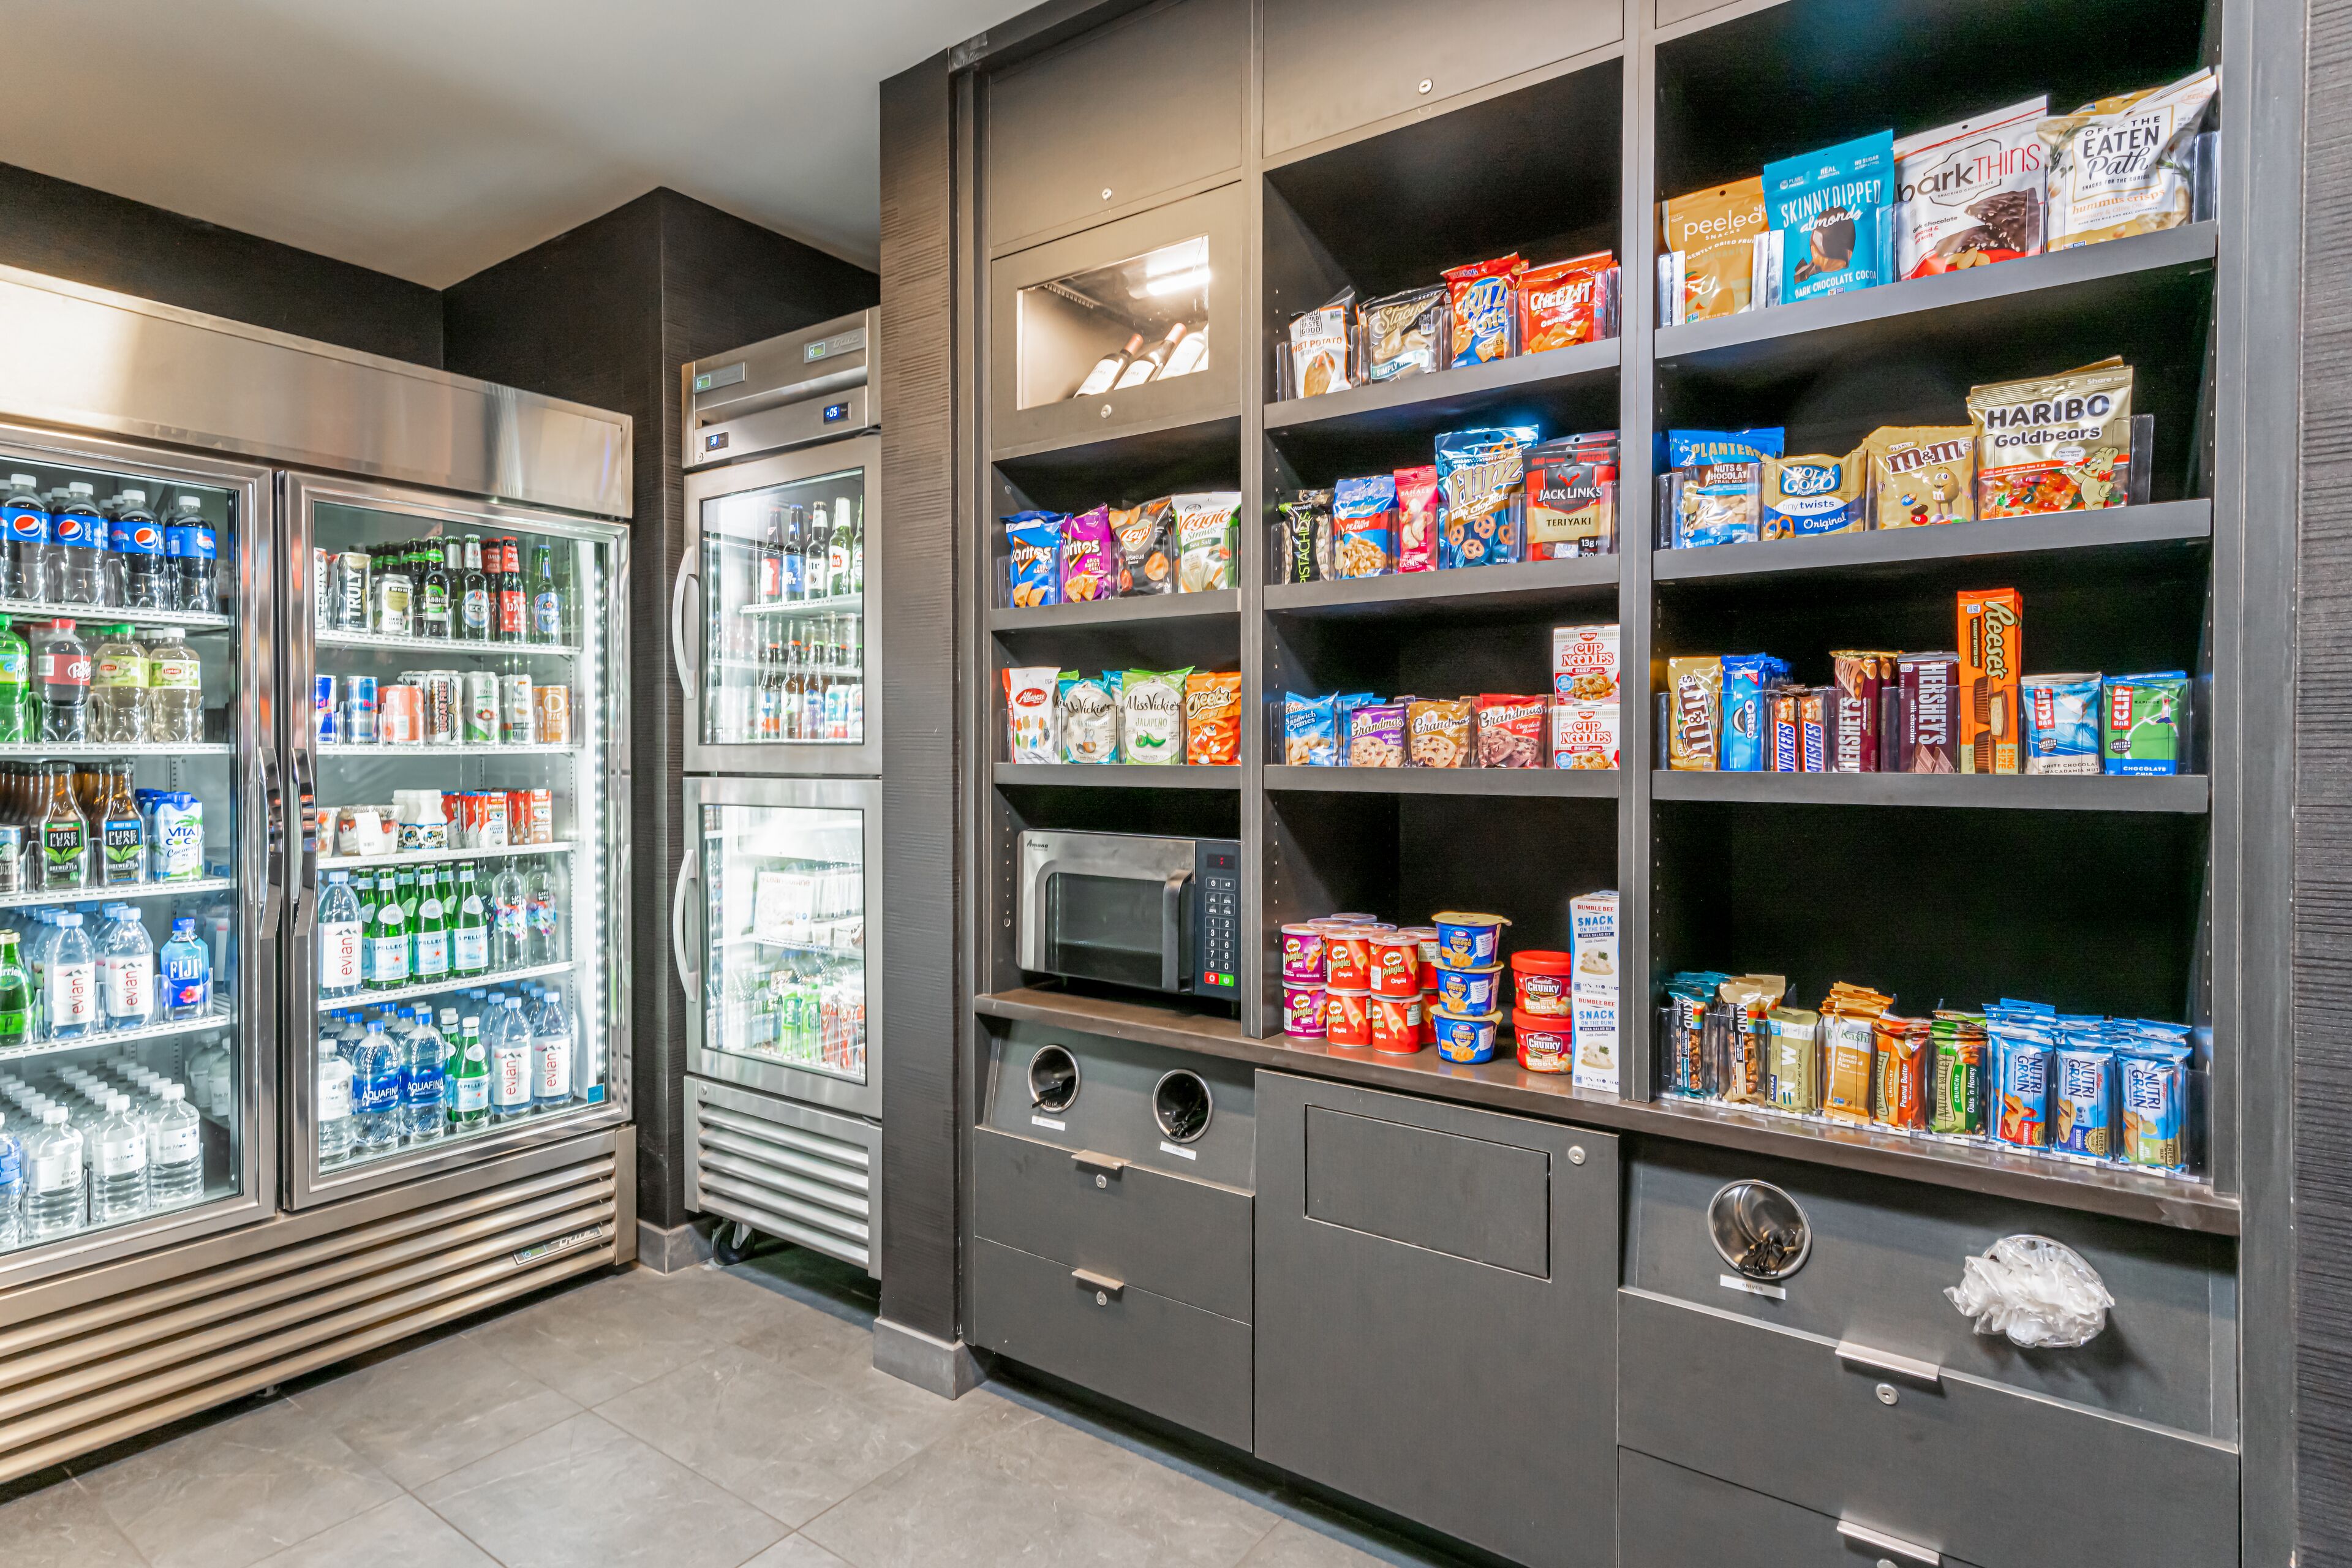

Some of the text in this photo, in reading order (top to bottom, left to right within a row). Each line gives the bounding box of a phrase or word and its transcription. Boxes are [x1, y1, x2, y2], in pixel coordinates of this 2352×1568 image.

[2132, 116, 2160, 127] THE
[2083, 126, 2160, 160] EATEN
[1820, 166, 1836, 175] REAL
[2087, 147, 2150, 180] Path
[1938, 181, 1994, 198] SNACKING CHOCOLATE
[2073, 188, 2166, 216] hummus crisps
[1684, 205, 1762, 242] peeled
[1799, 204, 1863, 233] almonds
[1705, 228, 1740, 241] SNACKS
[1795, 270, 1877, 300] DARK CHOCOLATE COCOA
[1378, 301, 1427, 332] Stacy's
[1376, 362, 1398, 377] SIMPLY
[826, 407, 838, 419] -05
[1986, 395, 2110, 429] HARIBO
[1994, 426, 2101, 448] Goldbears
[1890, 442, 1915, 452] PEANUT
[1714, 464, 1735, 473] NUTS
[1401, 488, 1430, 497] SAHALE
[1449, 458, 1523, 512] Flipz
[1783, 475, 1836, 494] GOLD
[1538, 487, 1603, 502] JACK LINK'S
[1783, 499, 1835, 512] tiny twists
[1178, 510, 1231, 535] Veggie
[1346, 521, 1370, 531] PEANUTS
[1547, 518, 1591, 527] TERIYAKI
[1803, 512, 1847, 530] Original
[1121, 523, 1152, 541] Lay's
[1186, 527, 1216, 542] Straws
[1581, 539, 1594, 548] 13g
[347, 570, 362, 617] TRULY
[1574, 643, 1604, 655] CUP
[1985, 601, 2017, 679] Reese's
[1562, 653, 1614, 666] NOODLES
[439, 681, 448, 733] SUGAR FREE
[1125, 693, 1181, 717] Miss Vickie's
[1918, 665, 1947, 745] HERSHEY'S
[2037, 690, 2052, 718] CLIF
[2114, 688, 2130, 717] CLIF
[1135, 717, 1168, 728] JALAPEÑO
[1286, 710, 1316, 725] Sandwich
[1287, 717, 1316, 731] Cremes
[1479, 704, 1544, 728] Grandma's
[1744, 699, 1757, 739] OREO
[1352, 717, 1403, 737] Grandma's
[1572, 722, 1602, 733] CUP
[1838, 697, 1861, 773] HERSHEY'S
[1561, 731, 1611, 744] NOODLES
[1997, 748, 2007, 769] SIZE
[2007, 748, 2015, 769] KING
[50, 832, 77, 841] PURE
[108, 831, 137, 840] PURE
[168, 827, 195, 837] VITA
[50, 837, 78, 846] LEAF
[108, 837, 137, 846] LEAF
[167, 843, 197, 858] Coconut
[1027, 839, 1049, 850] Amana
[1577, 915, 1614, 927] SNACK
[341, 937, 353, 976] evian
[1286, 951, 1304, 963] Pringles
[1331, 959, 1351, 971] Pringles
[170, 959, 200, 979] FIJI
[1382, 965, 1405, 979] Pringles
[72, 977, 84, 1015] evian
[126, 970, 138, 1007] evian
[1527, 982, 1559, 993] CHUNKY
[1292, 1007, 1313, 1021] Pringles
[1578, 1010, 1615, 1020] SNACK
[1683, 1000, 1694, 1028] KIND
[1736, 1003, 1747, 1033] KIND
[1528, 1038, 1561, 1051] CHUNKY
[1841, 1029, 1870, 1044] Kashi
[1838, 1051, 1858, 1061] Honey
[1838, 1057, 1863, 1066] Almond
[505, 1056, 517, 1095] evian
[546, 1051, 557, 1087] evian
[2016, 1055, 2030, 1094] GRAIN
[2029, 1057, 2043, 1095] NUTRI
[407, 1077, 444, 1093] AQUAFINA
[1968, 1068, 1977, 1089] Honey
[2068, 1059, 2082, 1098] GRAIN
[2080, 1061, 2095, 1099] NUTRI
[1937, 1057, 1953, 1119] NATURE VALLEY
[2132, 1069, 2148, 1110] GRAIN
[2144, 1072, 2161, 1110] NUTRI
